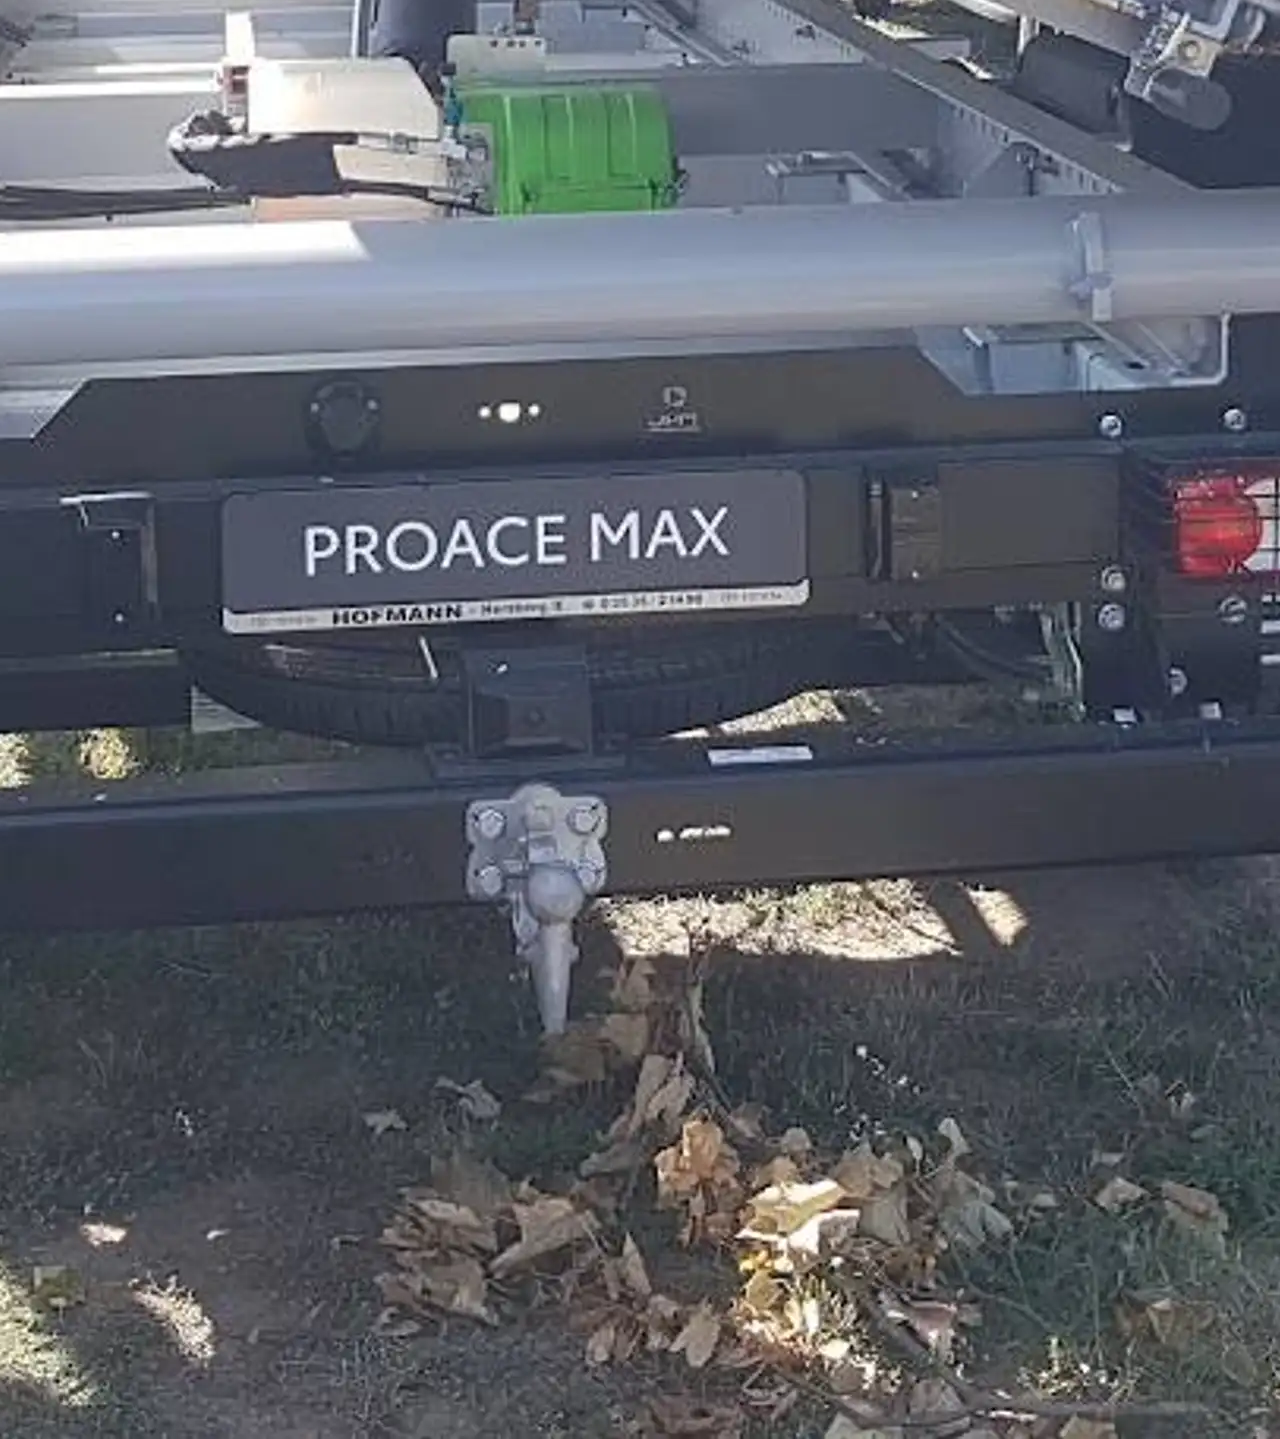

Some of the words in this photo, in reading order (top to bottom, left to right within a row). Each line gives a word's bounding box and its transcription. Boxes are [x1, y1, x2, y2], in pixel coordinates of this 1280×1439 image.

[304, 515, 567, 576] PROACE
[589, 506, 729, 562] MAX
[333, 604, 462, 625] HOFMANN
